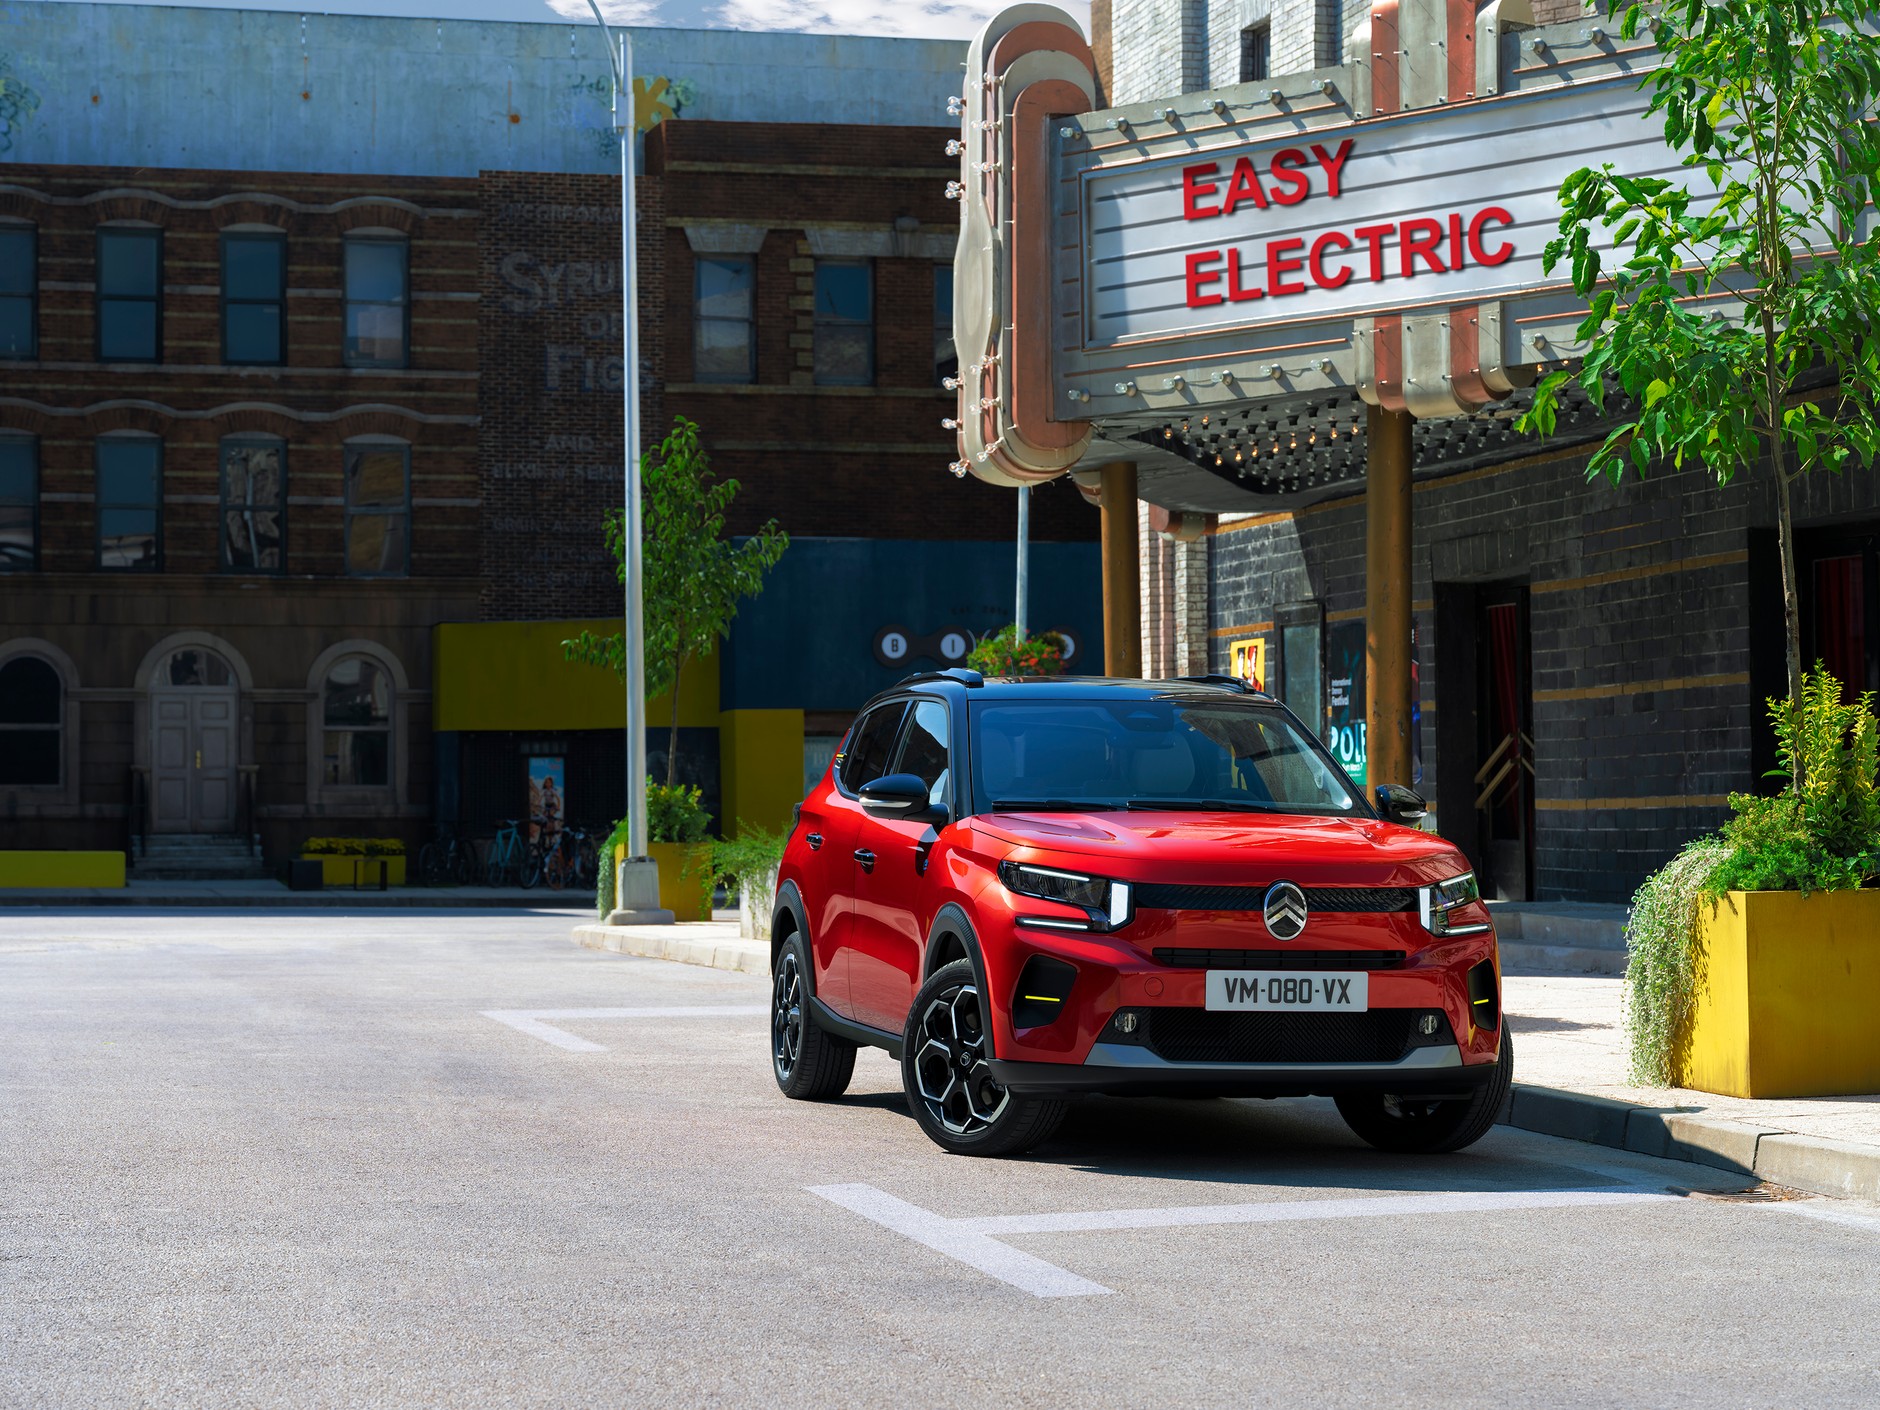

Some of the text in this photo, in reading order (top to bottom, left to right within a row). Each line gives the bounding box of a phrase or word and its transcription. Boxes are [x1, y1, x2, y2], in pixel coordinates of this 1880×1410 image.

[1183, 139, 1354, 220] EASY
[1185, 207, 1514, 308] ELECTRIC
[1331, 695, 1350, 707] Festival
[1224, 977, 1351, 1004] VM-080-VX
